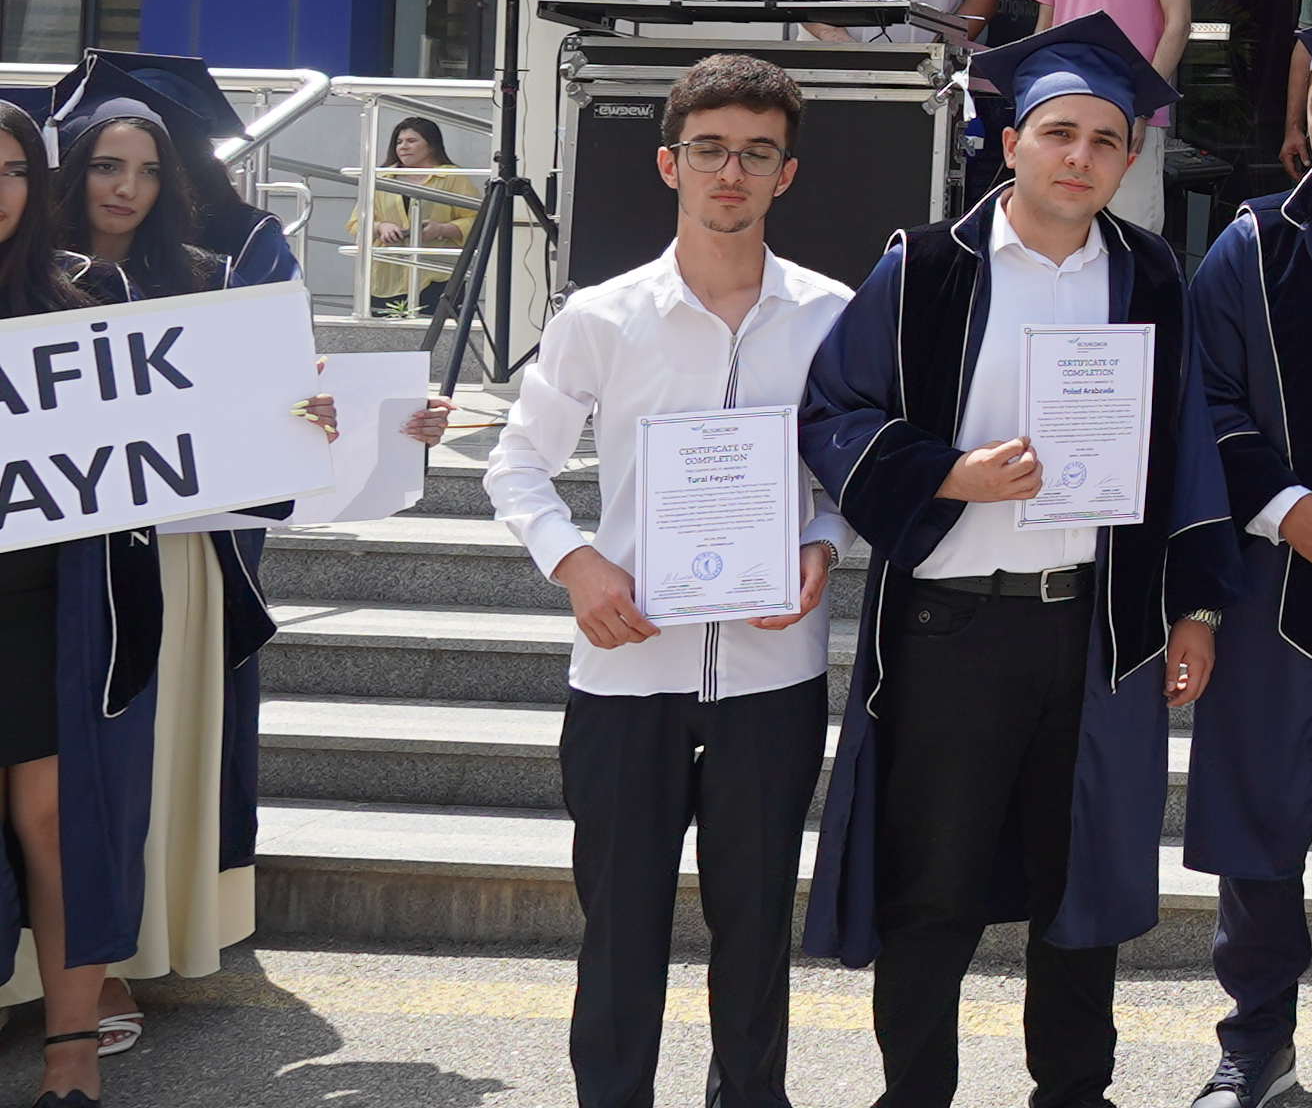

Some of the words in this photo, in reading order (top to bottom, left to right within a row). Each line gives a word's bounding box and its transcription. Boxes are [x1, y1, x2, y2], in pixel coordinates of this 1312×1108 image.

[679, 444, 740, 456] CERTIFICATE
[741, 443, 754, 451] OF
[684, 454, 749, 466] COMPLETION
